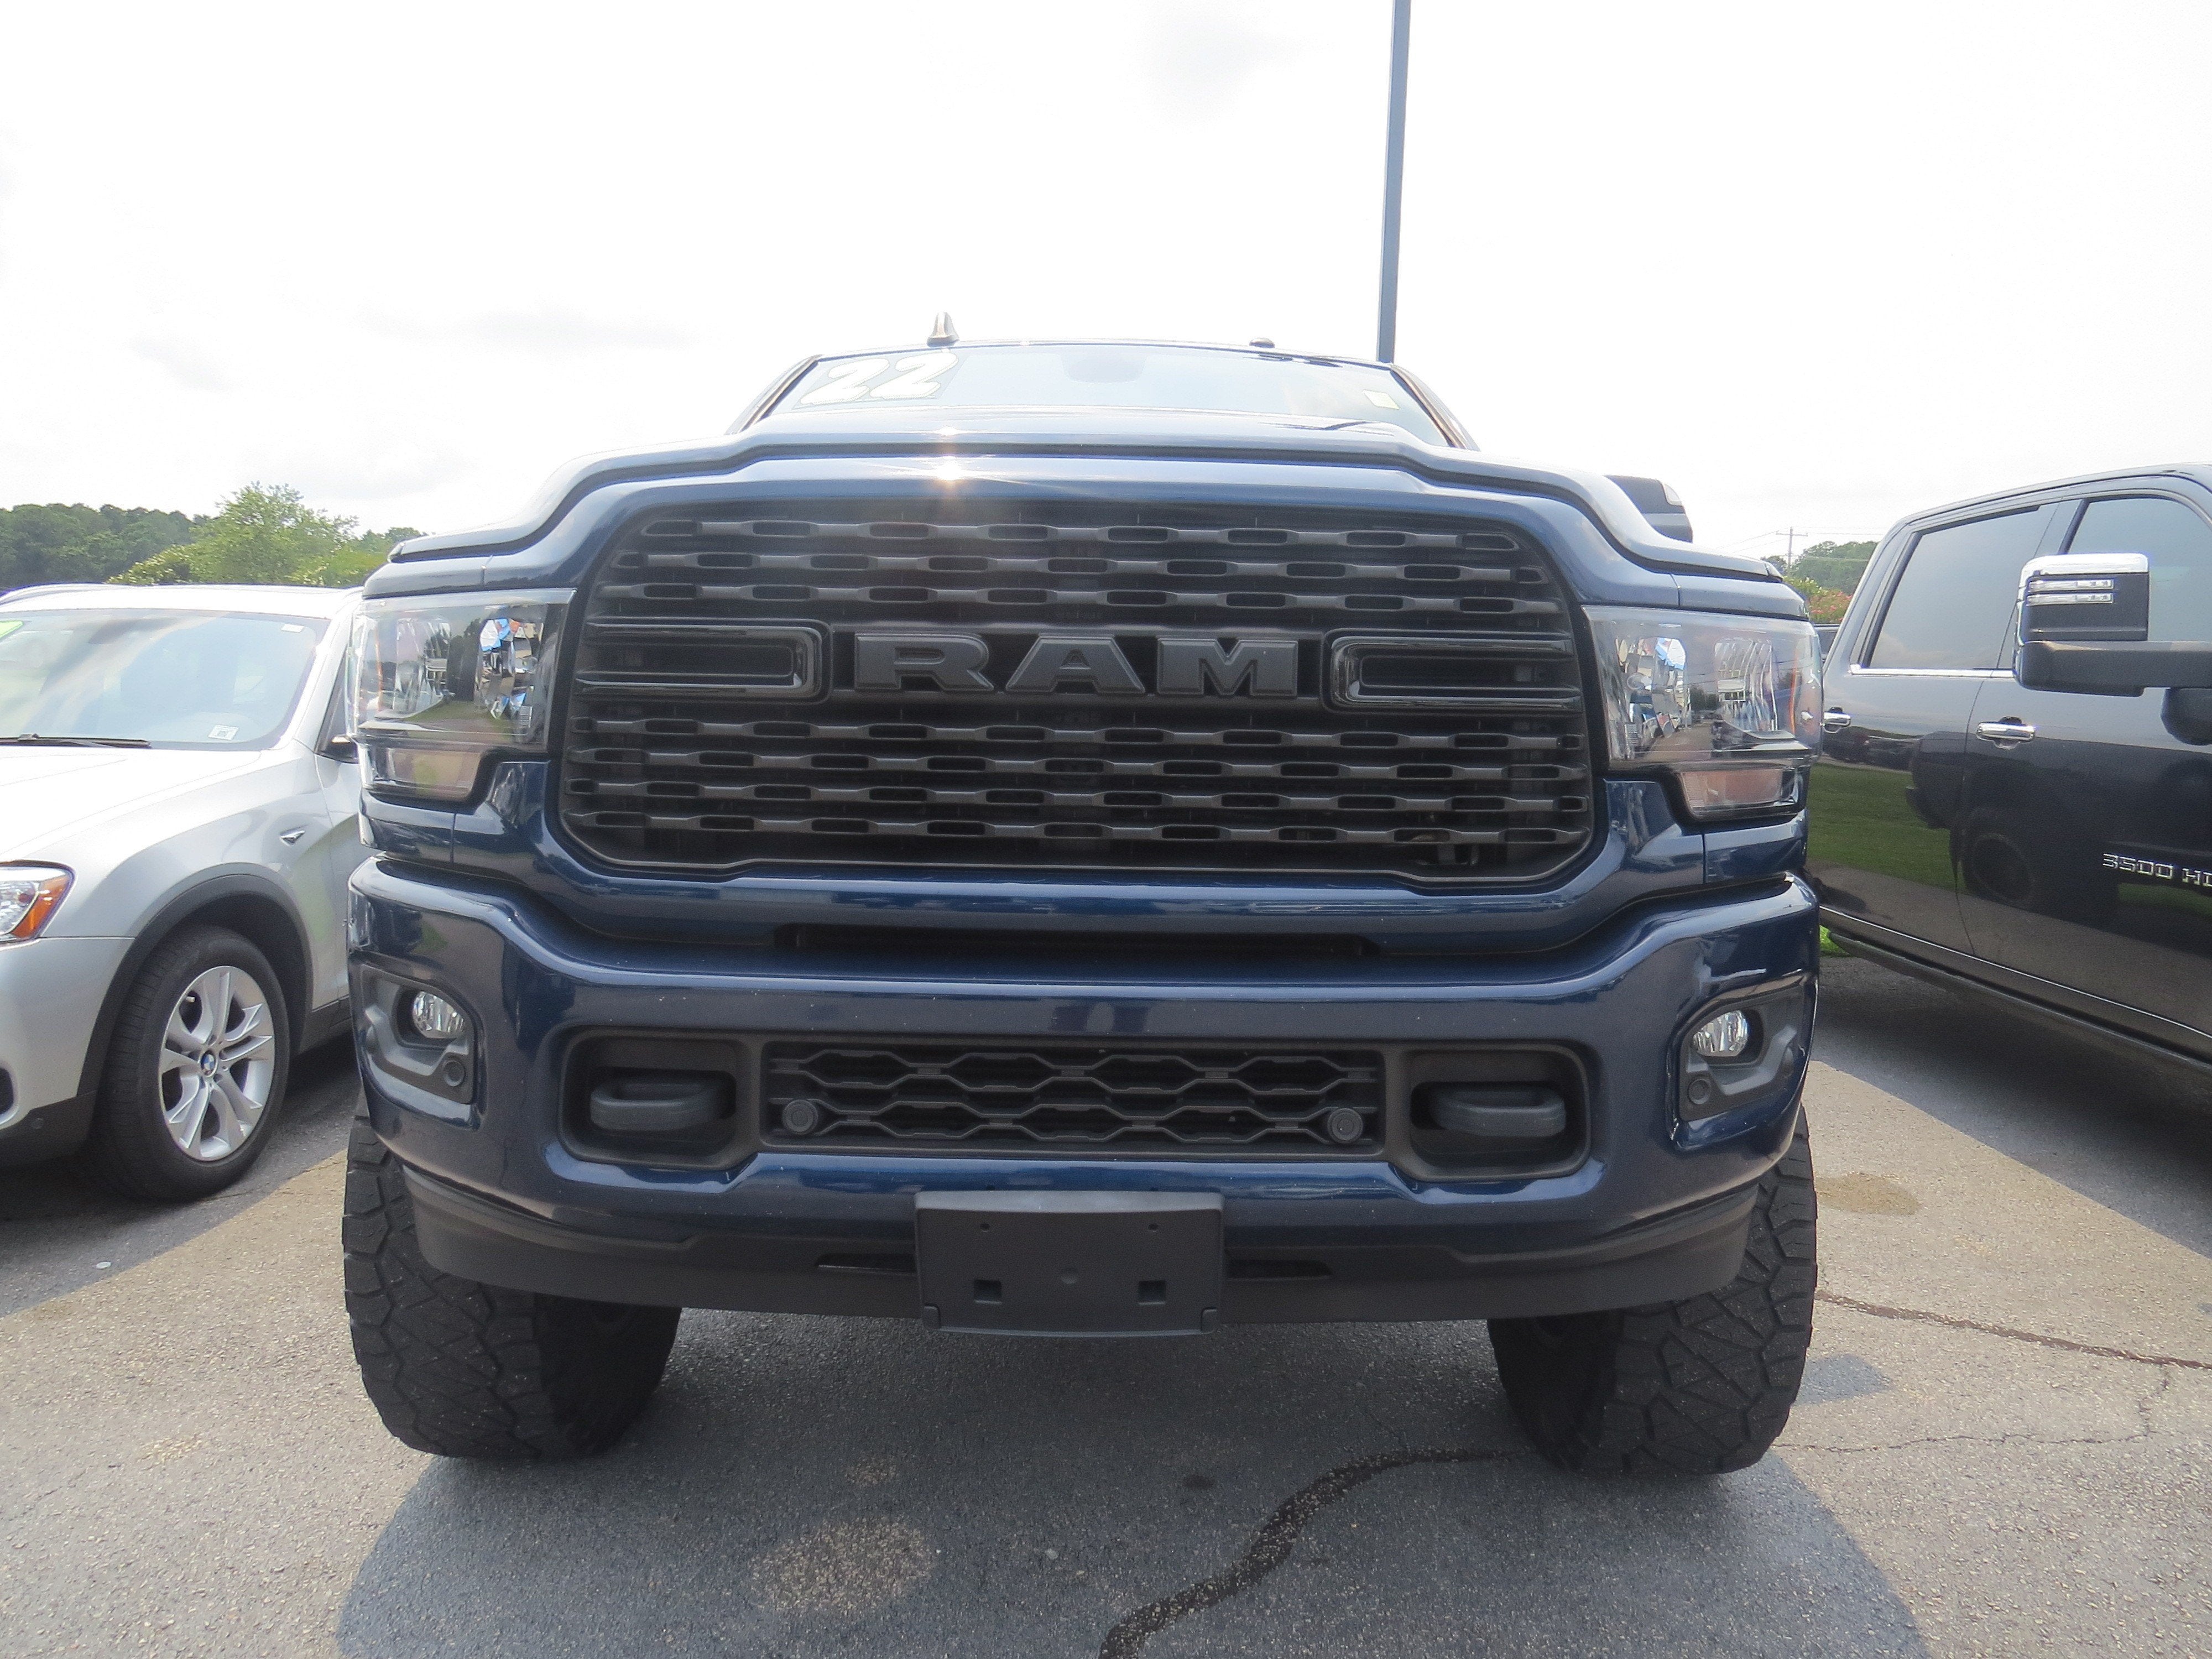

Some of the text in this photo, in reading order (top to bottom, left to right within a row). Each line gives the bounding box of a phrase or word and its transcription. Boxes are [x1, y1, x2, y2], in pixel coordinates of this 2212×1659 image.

[800, 351, 958, 404] 22
[854, 632, 1299, 696] RAM
[2103, 853, 2173, 879] 3500
